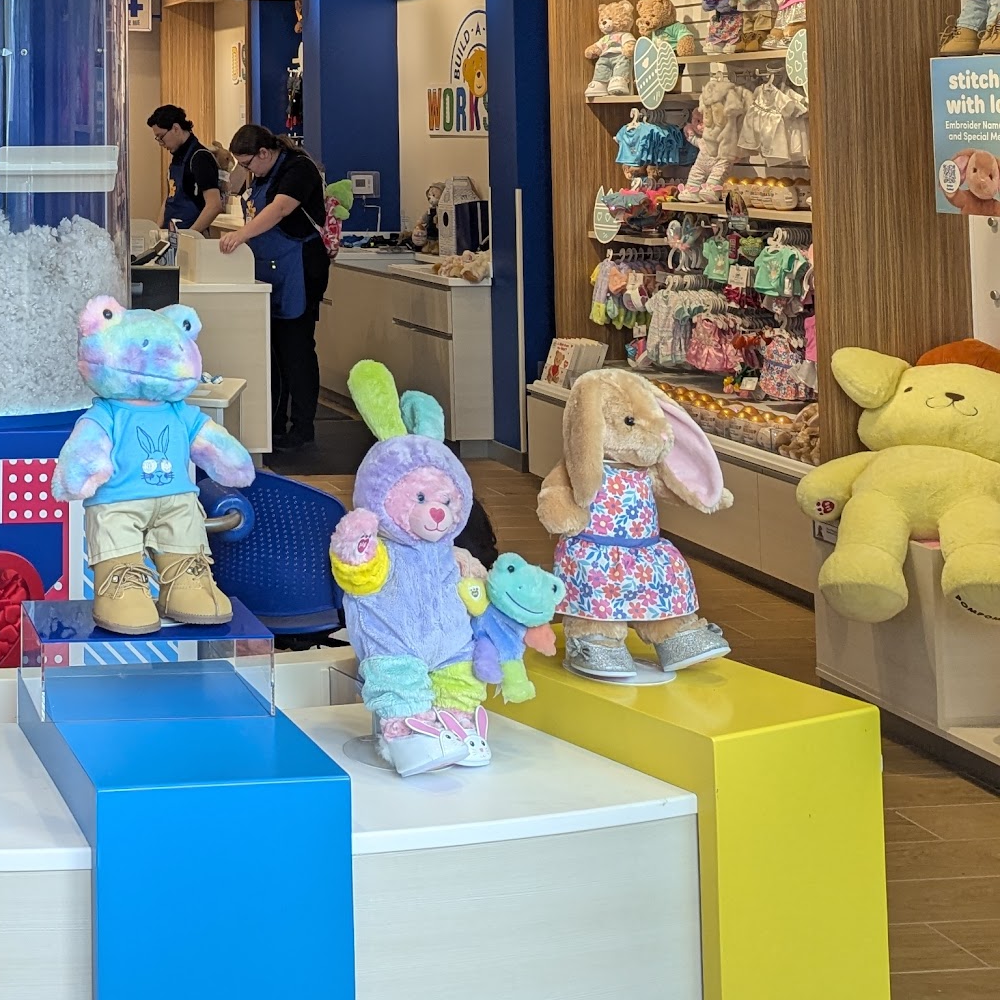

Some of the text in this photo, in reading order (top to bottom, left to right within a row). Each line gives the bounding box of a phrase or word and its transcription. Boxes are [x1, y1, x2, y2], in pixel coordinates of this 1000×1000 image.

[949, 69, 999, 89] stitch
[946, 94, 985, 114] with
[945, 120, 1000, 130] Embroider Nam
[948, 132, 962, 141] and
[963, 132, 989, 143] Special
